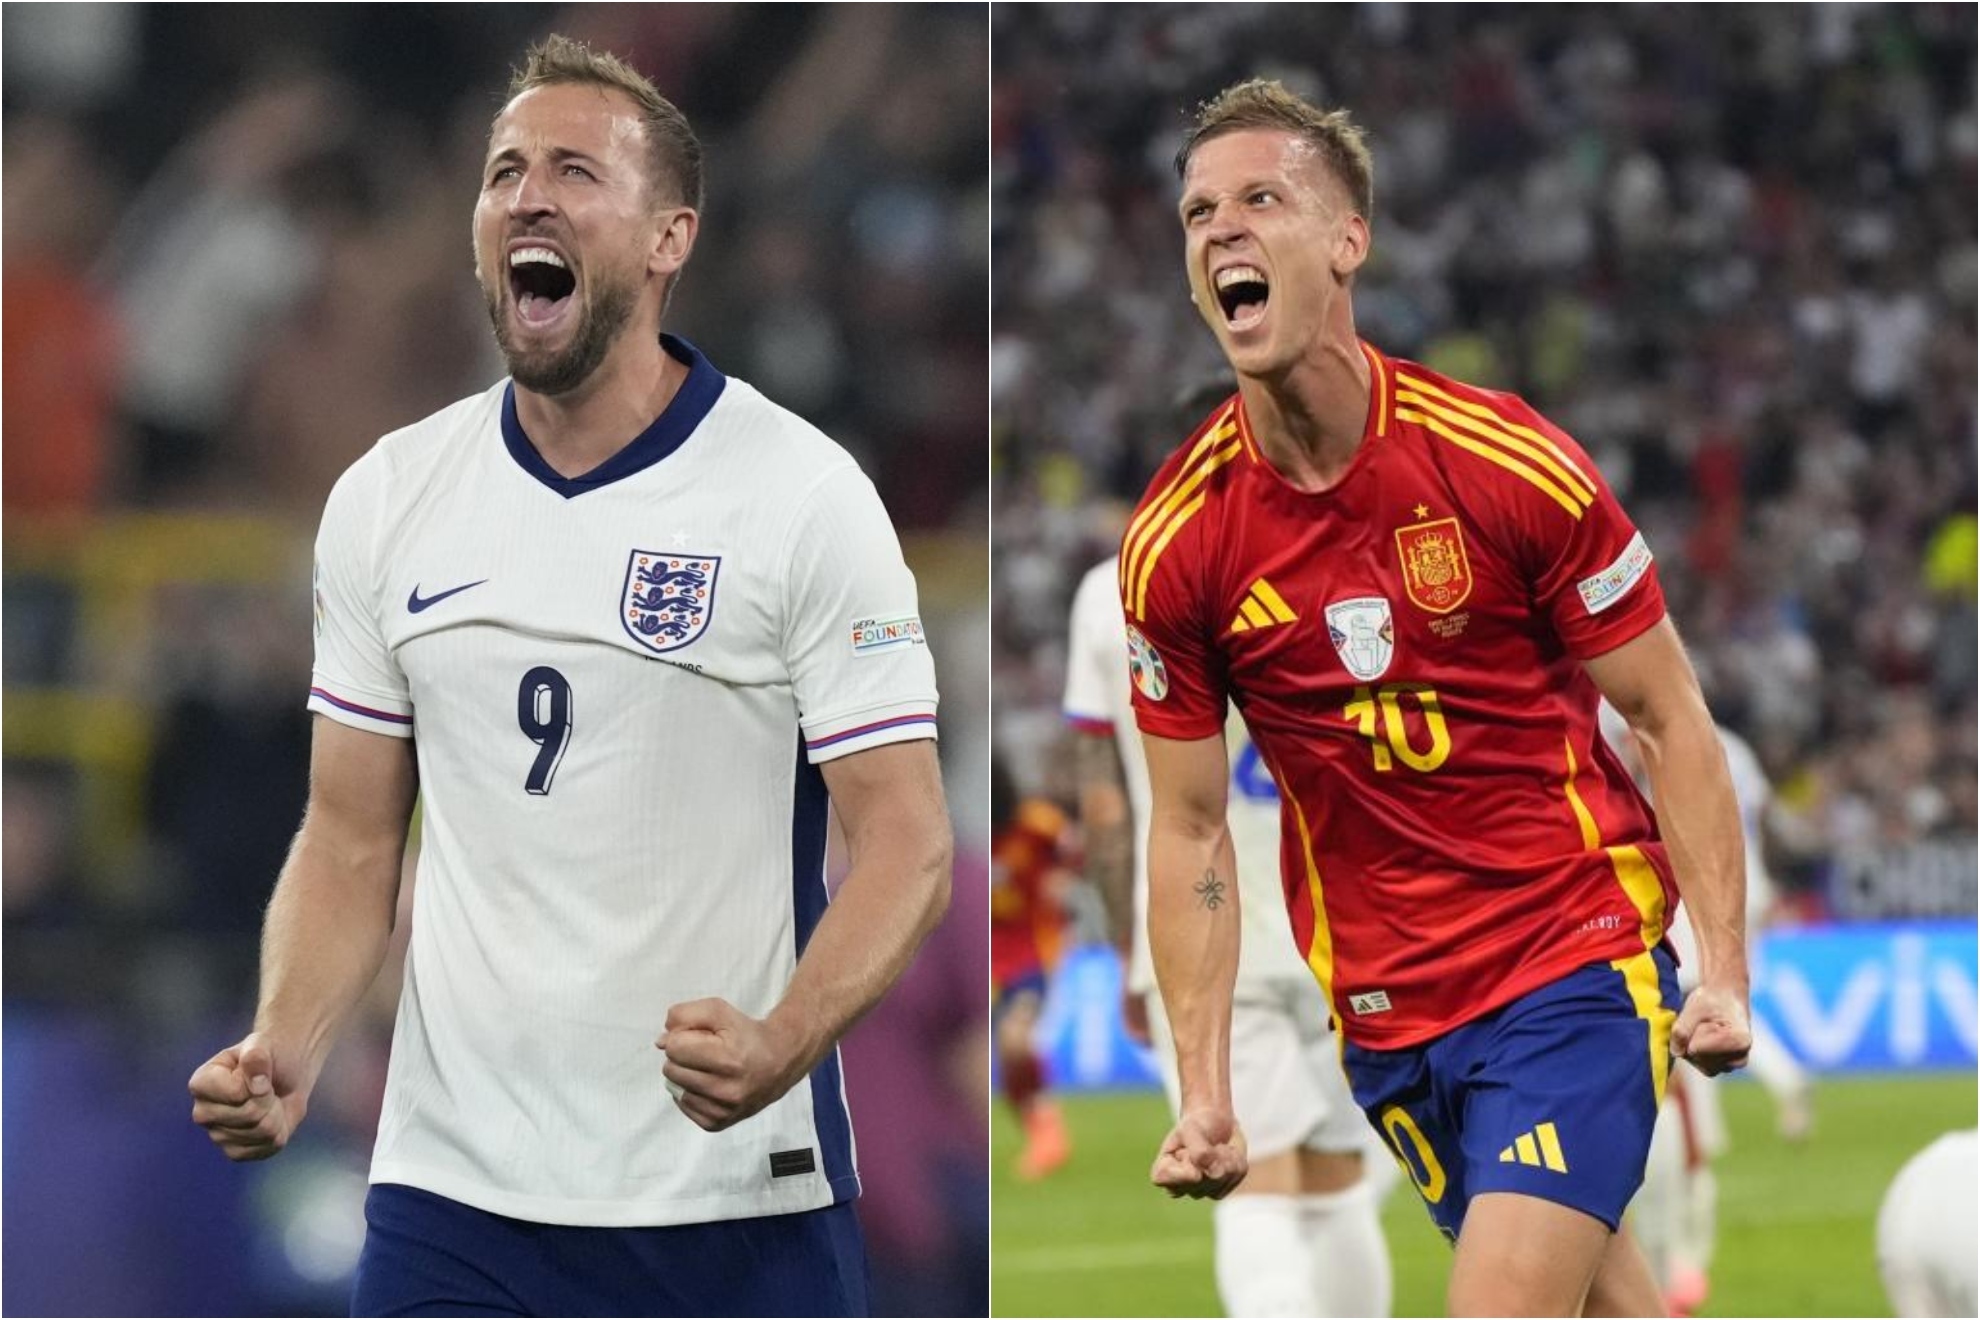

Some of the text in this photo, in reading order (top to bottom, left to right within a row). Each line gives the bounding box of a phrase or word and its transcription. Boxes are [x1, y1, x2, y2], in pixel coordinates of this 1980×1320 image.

[852, 618, 876, 631] UEFA
[518, 666, 573, 796] 9
[1344, 682, 1452, 773] 10
[1382, 1103, 1447, 1205] 0
